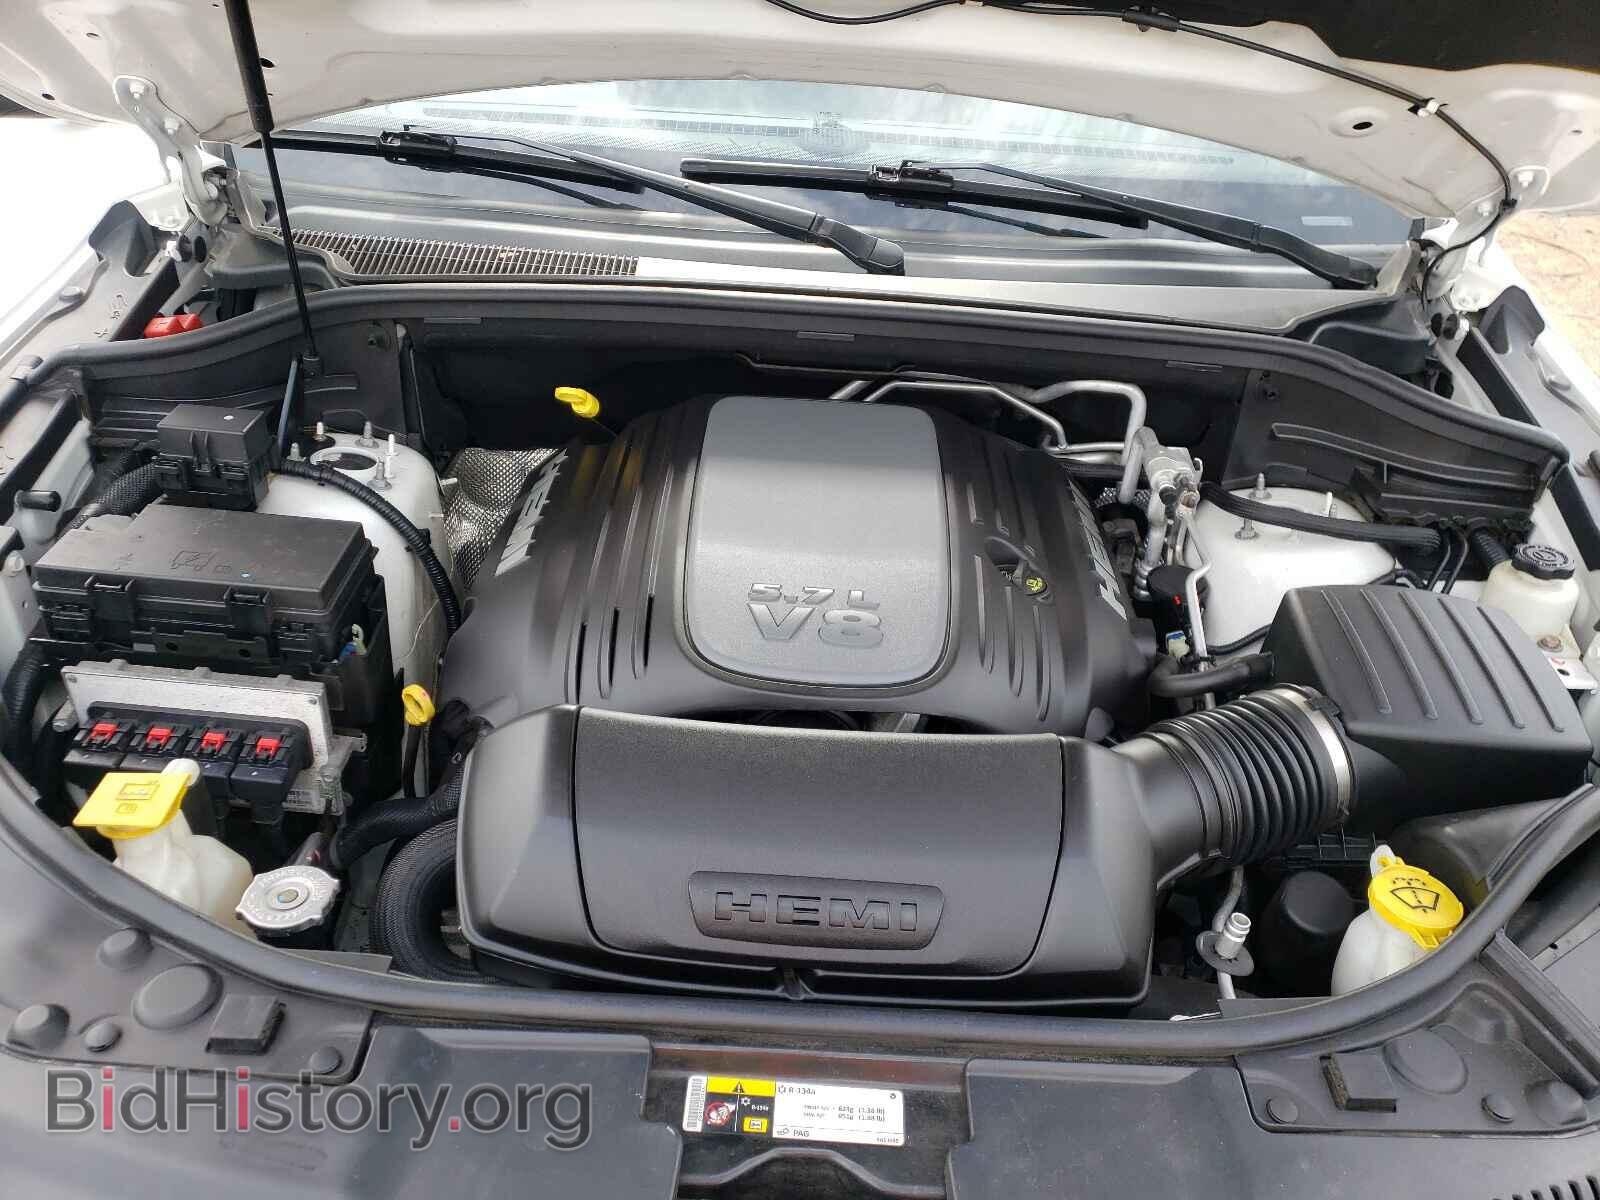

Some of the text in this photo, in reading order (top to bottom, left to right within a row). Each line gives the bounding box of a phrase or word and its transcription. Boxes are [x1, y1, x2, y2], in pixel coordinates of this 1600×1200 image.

[746, 602, 884, 648] V8
[714, 891, 918, 932] HEMI
[793, 1129, 810, 1138] PAG
